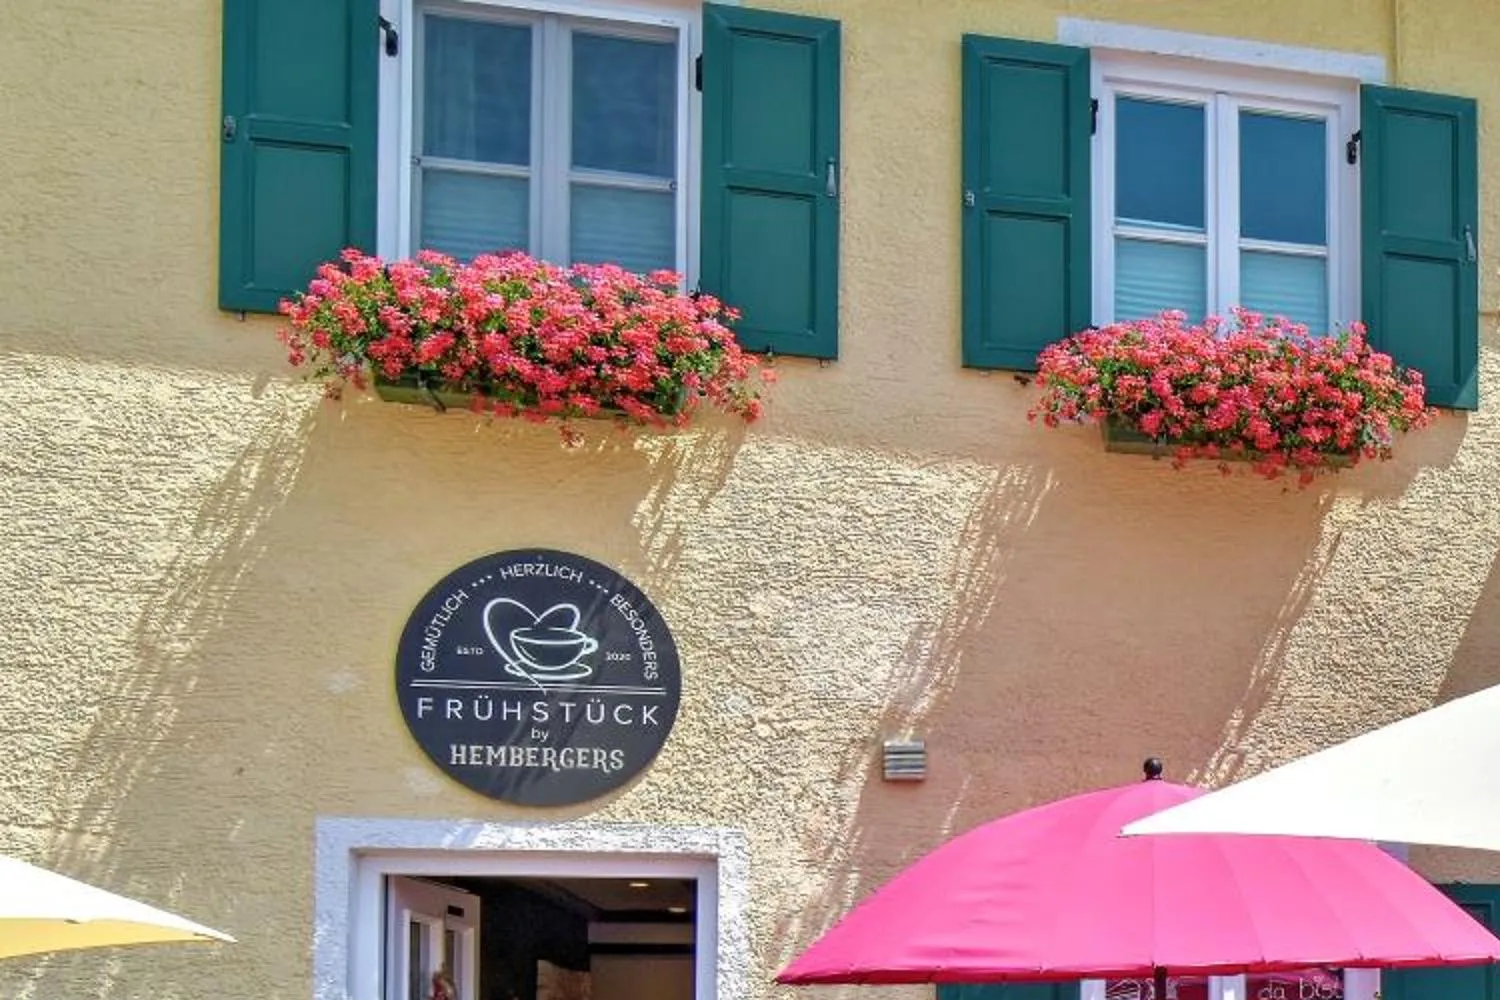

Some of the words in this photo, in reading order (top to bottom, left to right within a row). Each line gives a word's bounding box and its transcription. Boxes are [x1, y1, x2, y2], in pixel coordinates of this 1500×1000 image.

[420, 589, 469, 673] GEMÜTLICH
[500, 563, 583, 584] HERZLICH
[609, 593, 659, 681] BESONDERS
[416, 694, 660, 726] FRÜHSTÜCK
[531, 727, 549, 741] by
[450, 744, 625, 773] HEMBERGERS
